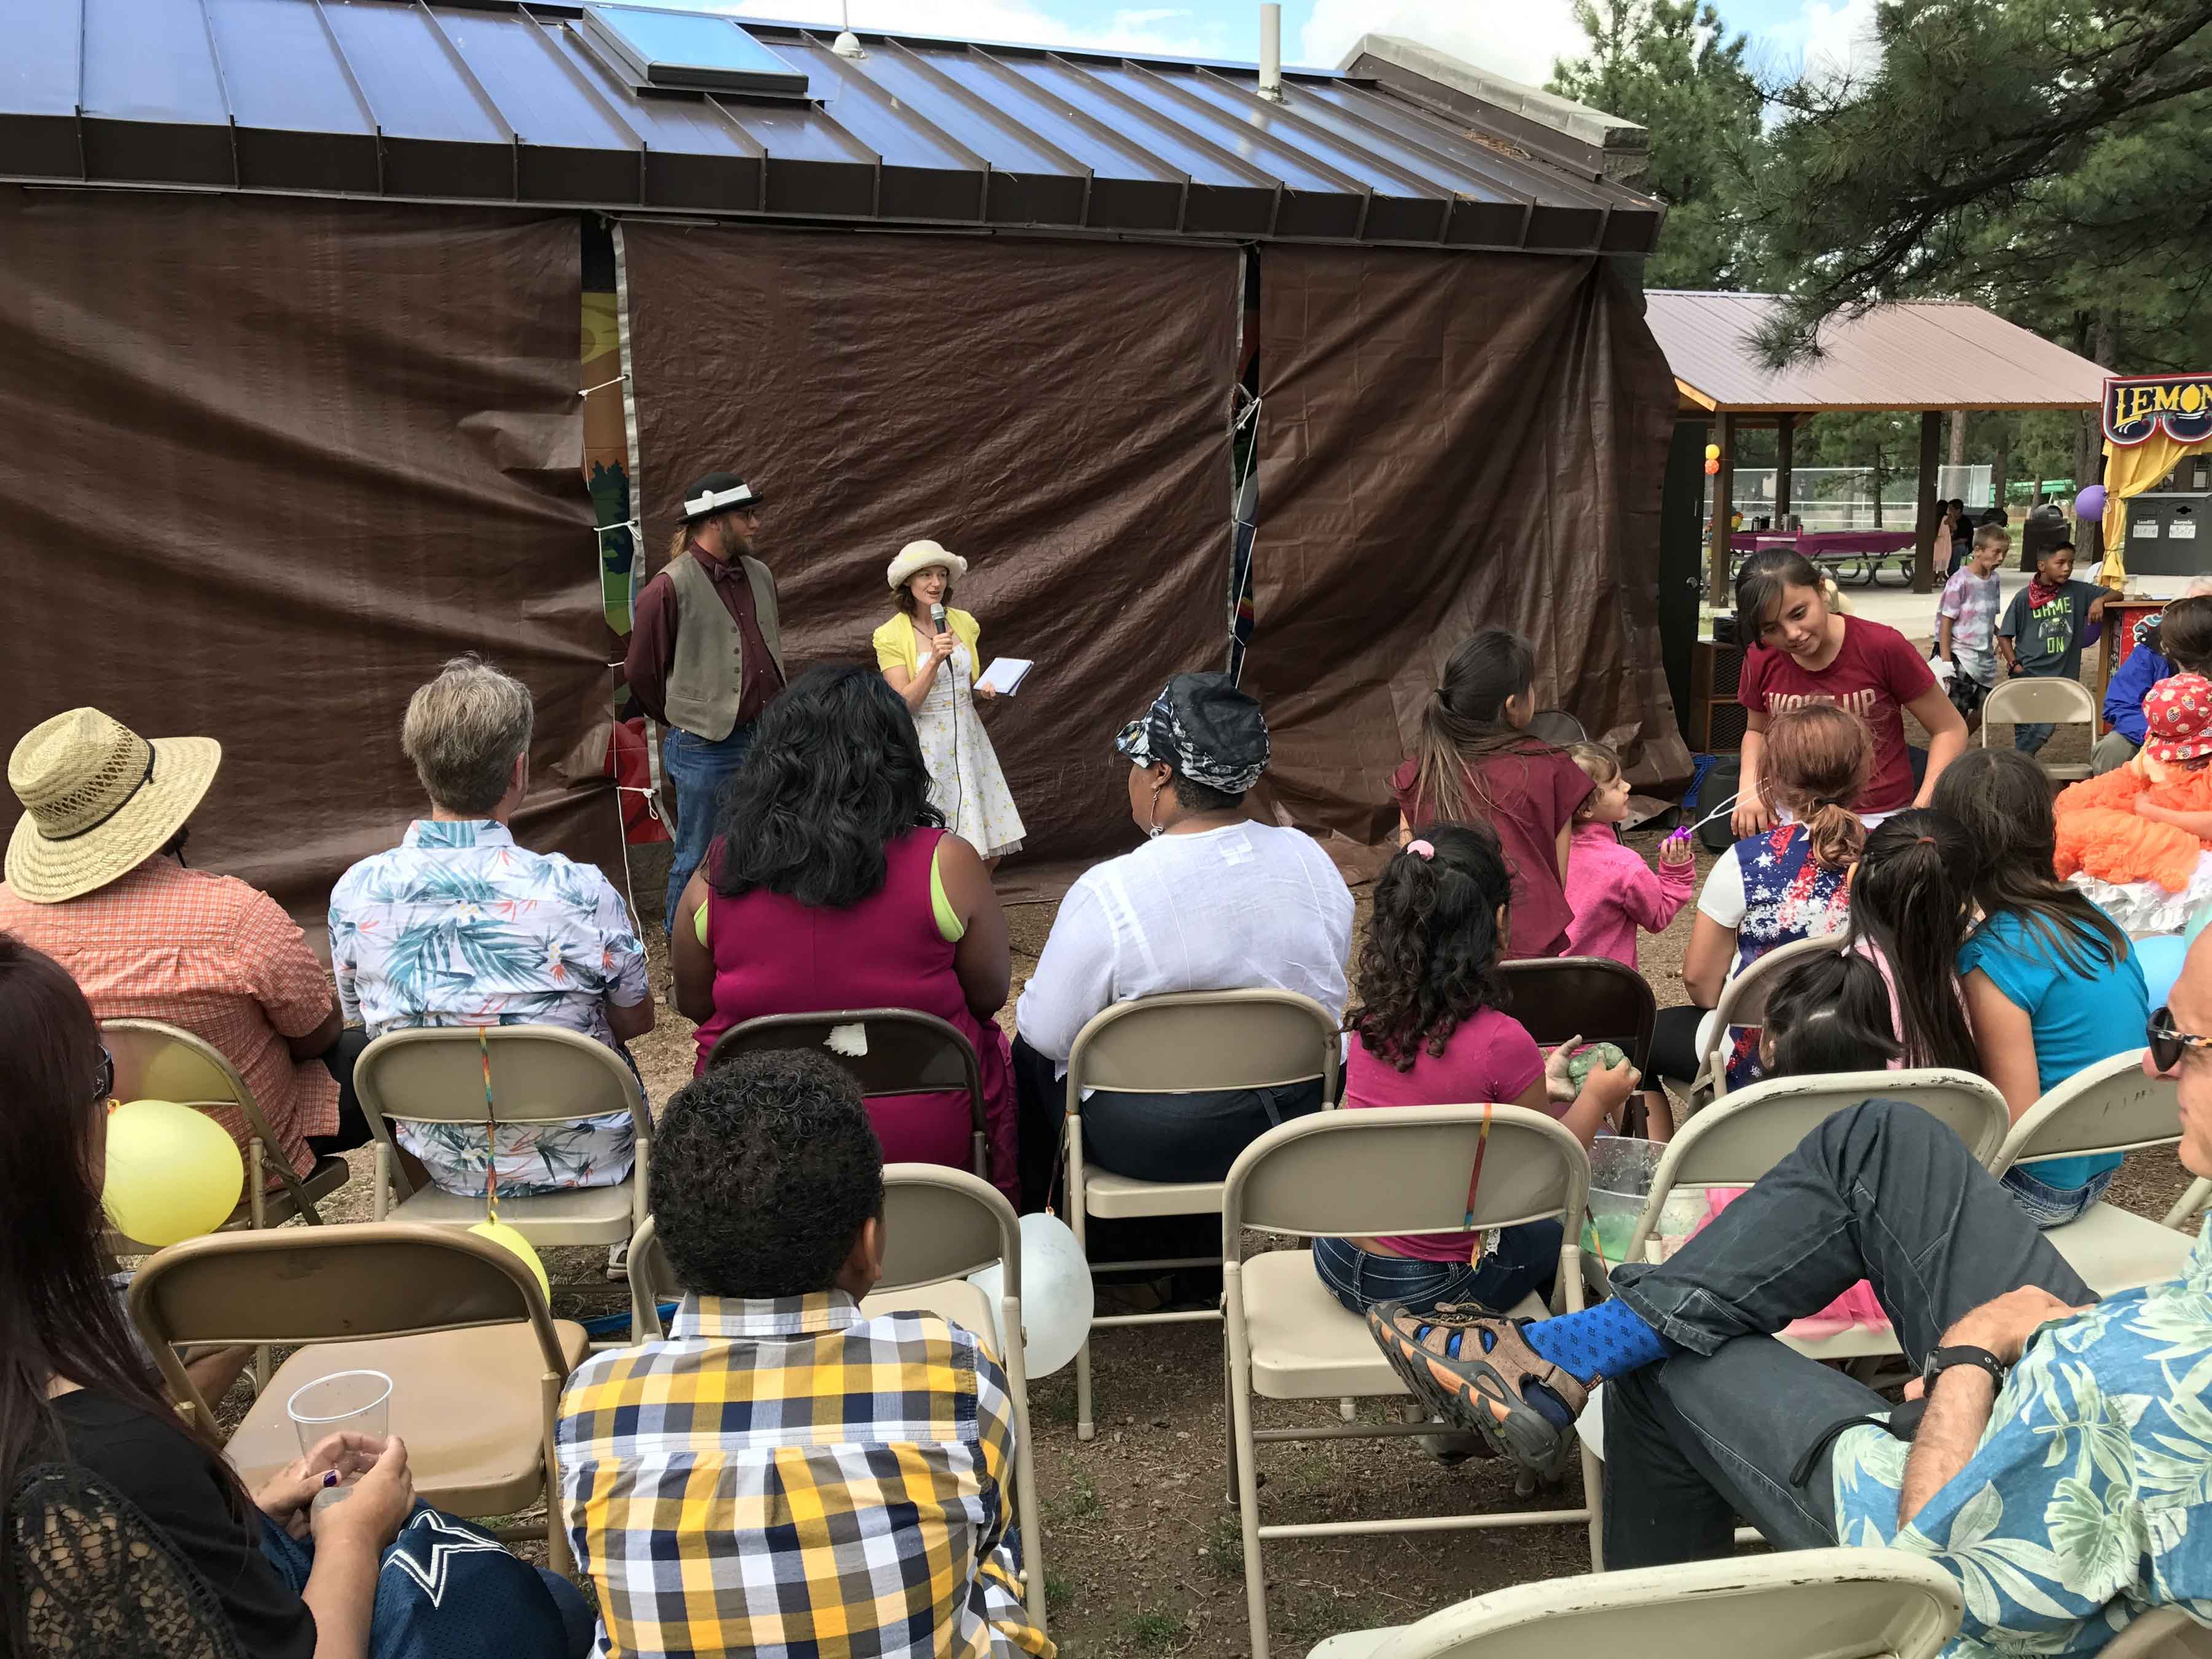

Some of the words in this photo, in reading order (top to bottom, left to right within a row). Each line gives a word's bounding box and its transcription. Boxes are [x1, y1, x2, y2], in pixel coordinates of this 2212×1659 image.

[2033, 597, 2072, 619] GAME
[2047, 636, 2065, 654] ON
[1769, 692, 1835, 718] WOK
[1843, 688, 1876, 718] UP
